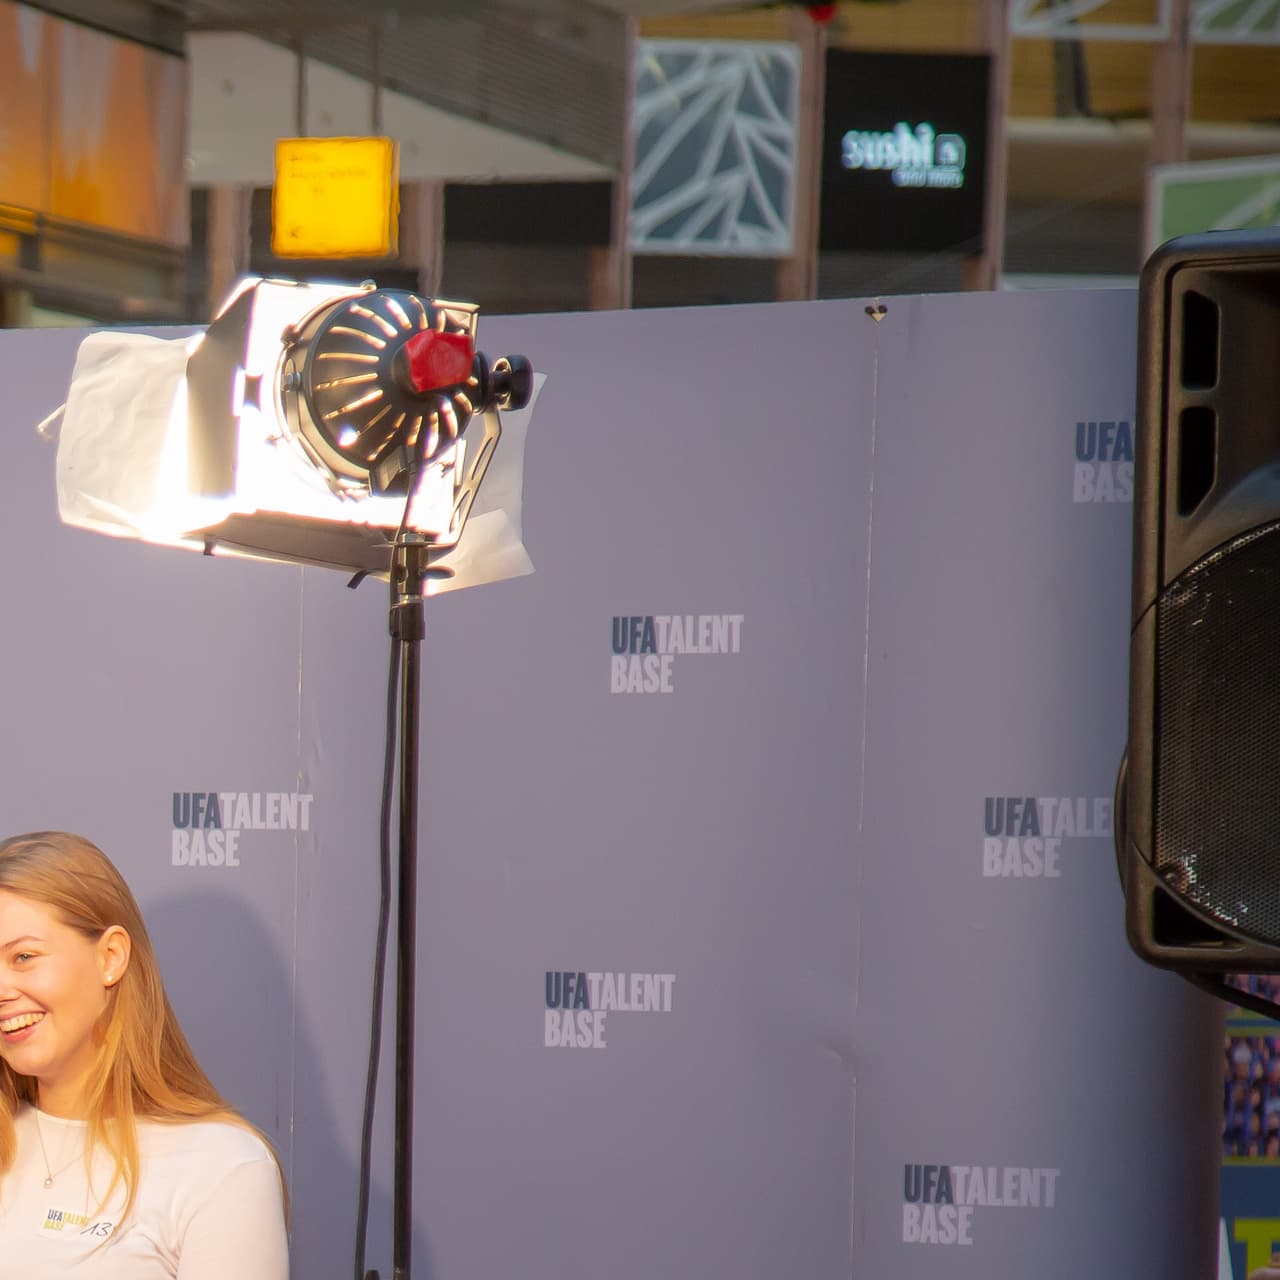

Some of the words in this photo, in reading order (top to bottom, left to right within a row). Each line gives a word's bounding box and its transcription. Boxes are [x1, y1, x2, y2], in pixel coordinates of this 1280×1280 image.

[1073, 462, 1133, 503] BAS
[610, 654, 674, 694] BASE
[984, 797, 1112, 837] UFATALE
[171, 829, 240, 867] BASE
[982, 838, 1061, 878] BASE
[544, 1011, 606, 1049] BASE
[80, 1222, 112, 1236] 13
[901, 1206, 973, 1246] BASE
